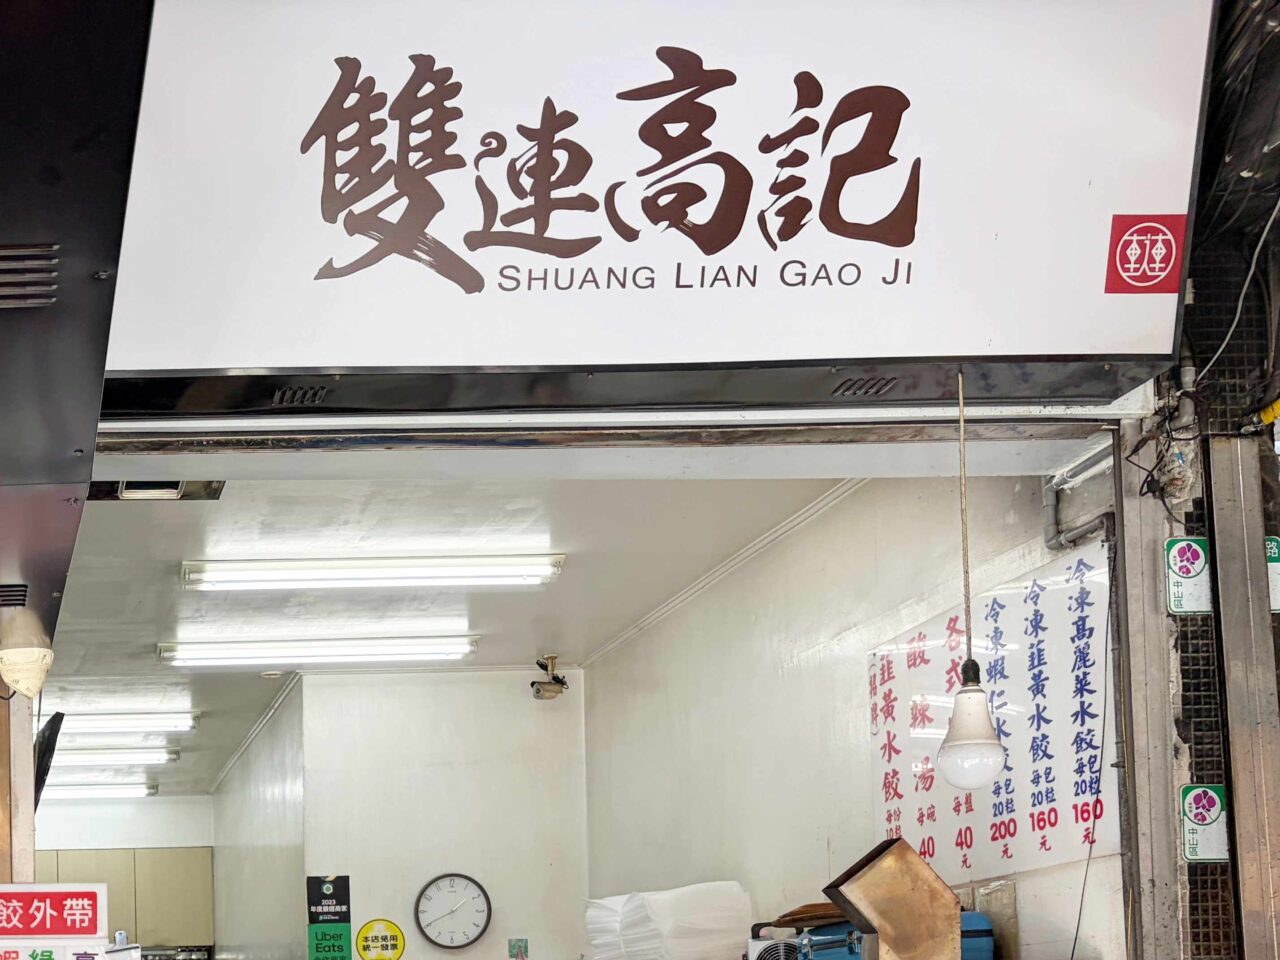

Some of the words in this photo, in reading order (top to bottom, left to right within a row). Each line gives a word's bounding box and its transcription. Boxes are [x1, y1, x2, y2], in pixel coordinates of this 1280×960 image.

[300, 45, 921, 295] 雙連高記
[906, 631, 935, 793] 酸辣湯
[1029, 807, 1058, 832] 160
[1072, 798, 1104, 825] 160
[955, 825, 974, 851] 40
[990, 817, 1017, 842] 200
[919, 835, 935, 860] 40
[315, 931, 343, 942] Uber
[315, 942, 345, 953] Eats
